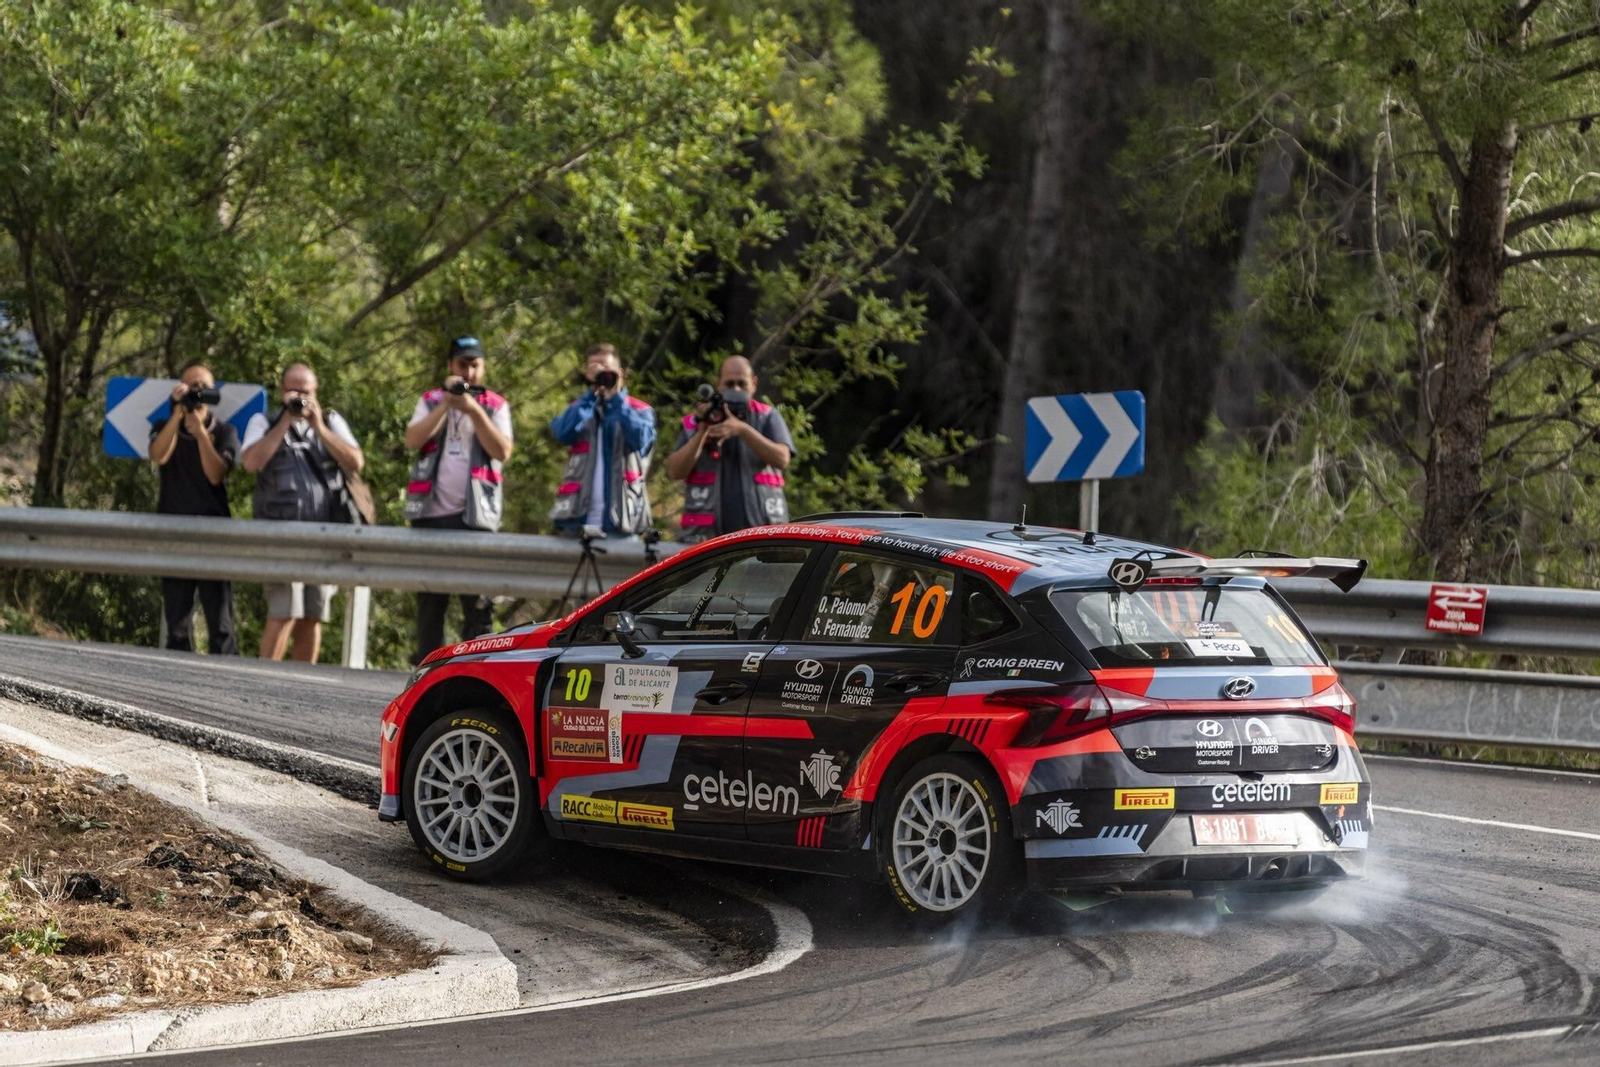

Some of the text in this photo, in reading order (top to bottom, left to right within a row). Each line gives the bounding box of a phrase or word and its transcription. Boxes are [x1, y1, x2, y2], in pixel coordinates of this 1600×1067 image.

[755, 525, 786, 536] forget
[835, 530, 853, 539] You
[854, 532, 882, 542] have
[882, 535, 893, 545] to
[893, 538, 919, 550] have
[919, 542, 938, 556] fun,
[938, 548, 954, 559] life
[955, 550, 966, 560] is
[966, 556, 983, 566] too
[818, 595, 866, 616] O. Palomo
[890, 582, 947, 638] 10
[812, 617, 872, 639] S. Fernández
[469, 637, 514, 651] HYUNDAI
[977, 658, 1065, 672] CRAIG BREEN
[628, 667, 671, 678] DIPUTACIÓN
[565, 668, 592, 701] 10
[628, 679, 671, 688] DE ALICANTE
[783, 681, 824, 694] HYUNDAI
[781, 692, 820, 702] MOTORSPORT
[843, 686, 875, 697] JUNIOR
[781, 701, 815, 712] Customer Racing
[840, 694, 872, 706] DRIVER
[563, 715, 573, 725] LA
[562, 741, 595, 754] Recalvi
[1195, 740, 1234, 749] HYUNDAI
[1251, 737, 1279, 745] JUNIOR
[1195, 749, 1234, 757] MOTORSPORT
[1251, 745, 1279, 755] DRIVER
[683, 769, 799, 815] cetelem
[1212, 780, 1291, 804] cetelem
[1325, 787, 1355, 800] PIRELLI
[1121, 792, 1169, 806] PIRELLI
[562, 799, 591, 817] RACC
[592, 803, 614, 813] Mobility
[623, 807, 668, 825] PIRELLI
